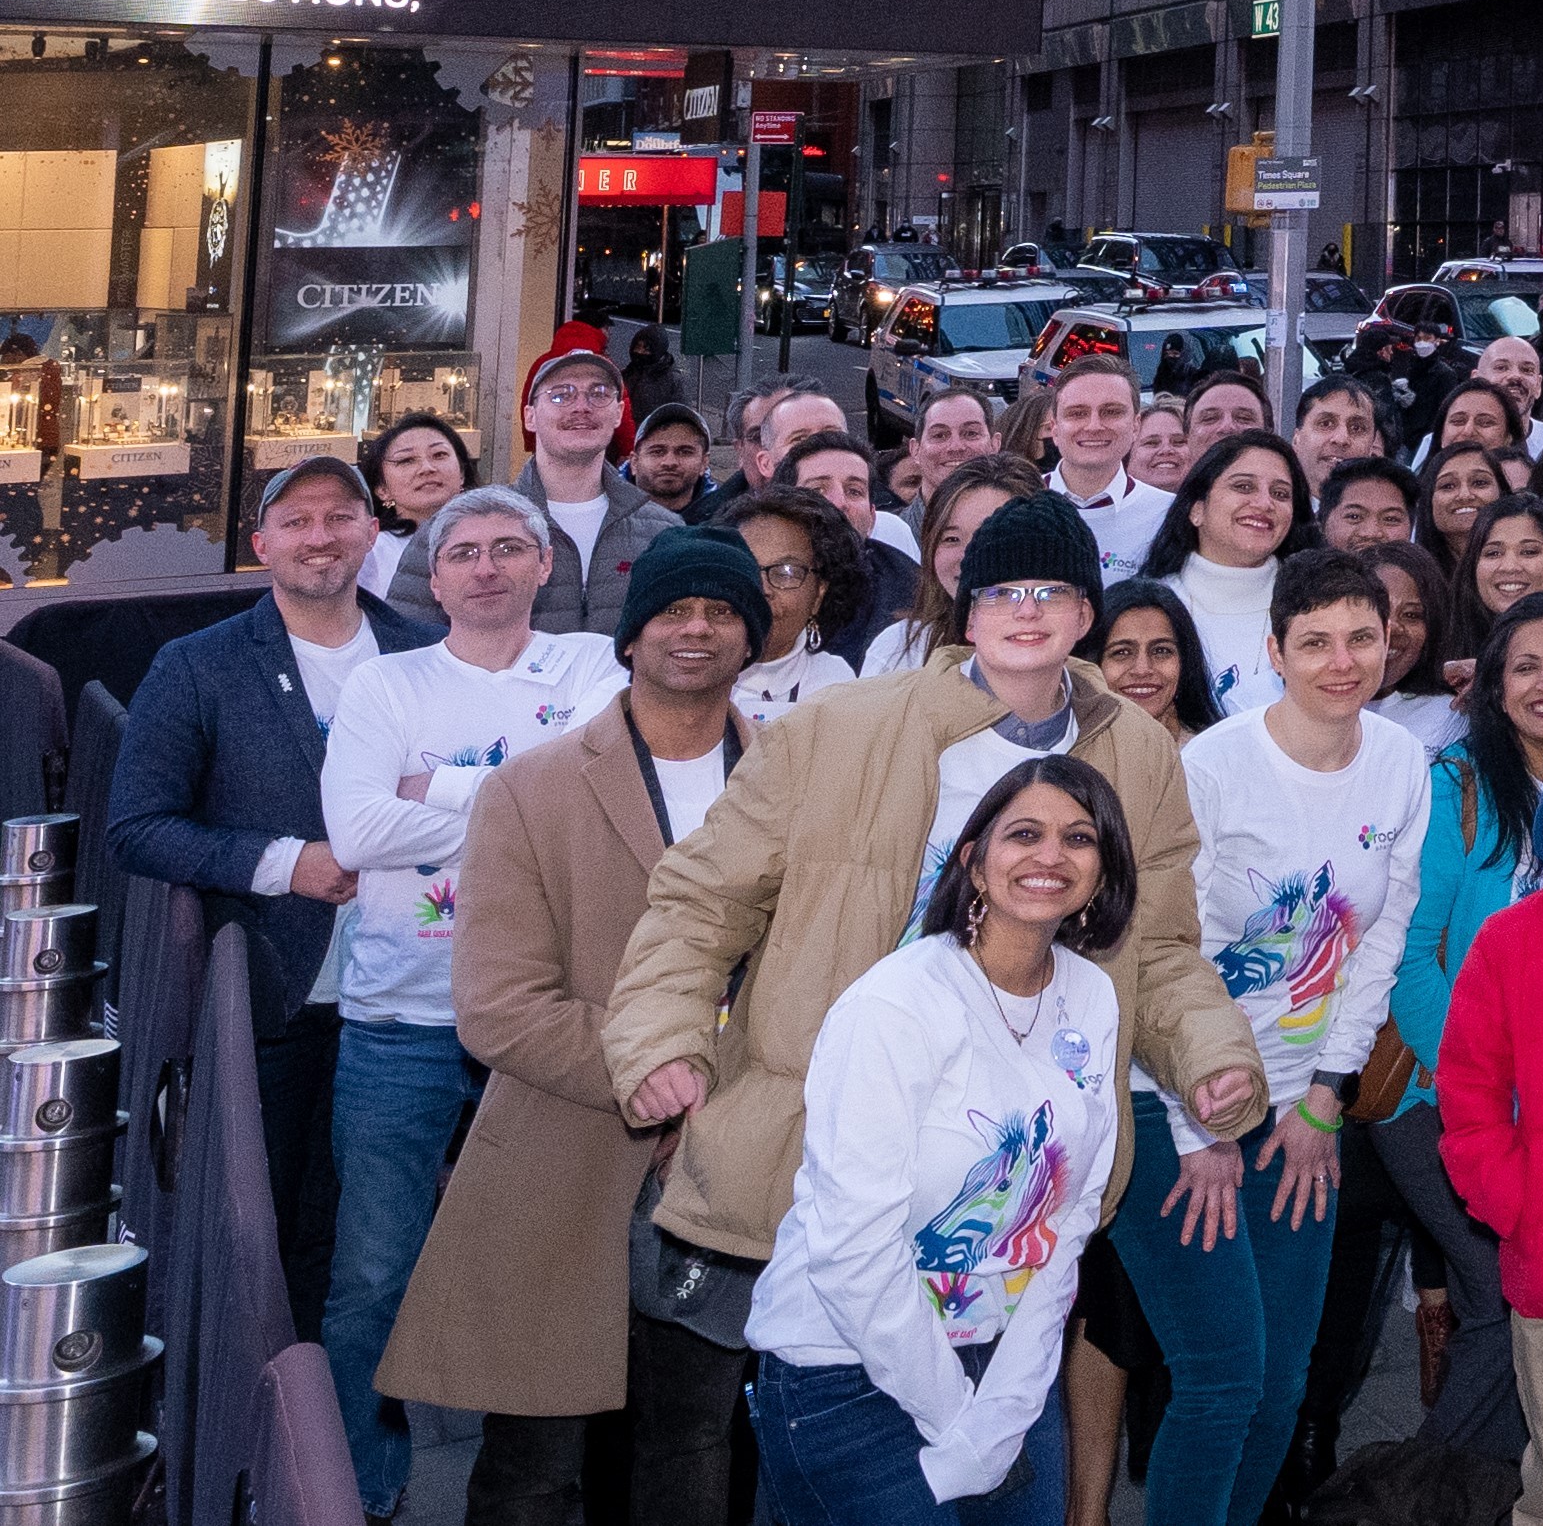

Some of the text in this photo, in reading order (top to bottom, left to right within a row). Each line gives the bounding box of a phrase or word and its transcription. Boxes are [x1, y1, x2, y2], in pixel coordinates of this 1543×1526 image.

[1254, 4, 1279, 32] W 43
[1258, 169, 1310, 180] Times Square
[297, 283, 440, 309] CITIZEN
[111, 450, 163, 463] CITIZEN
